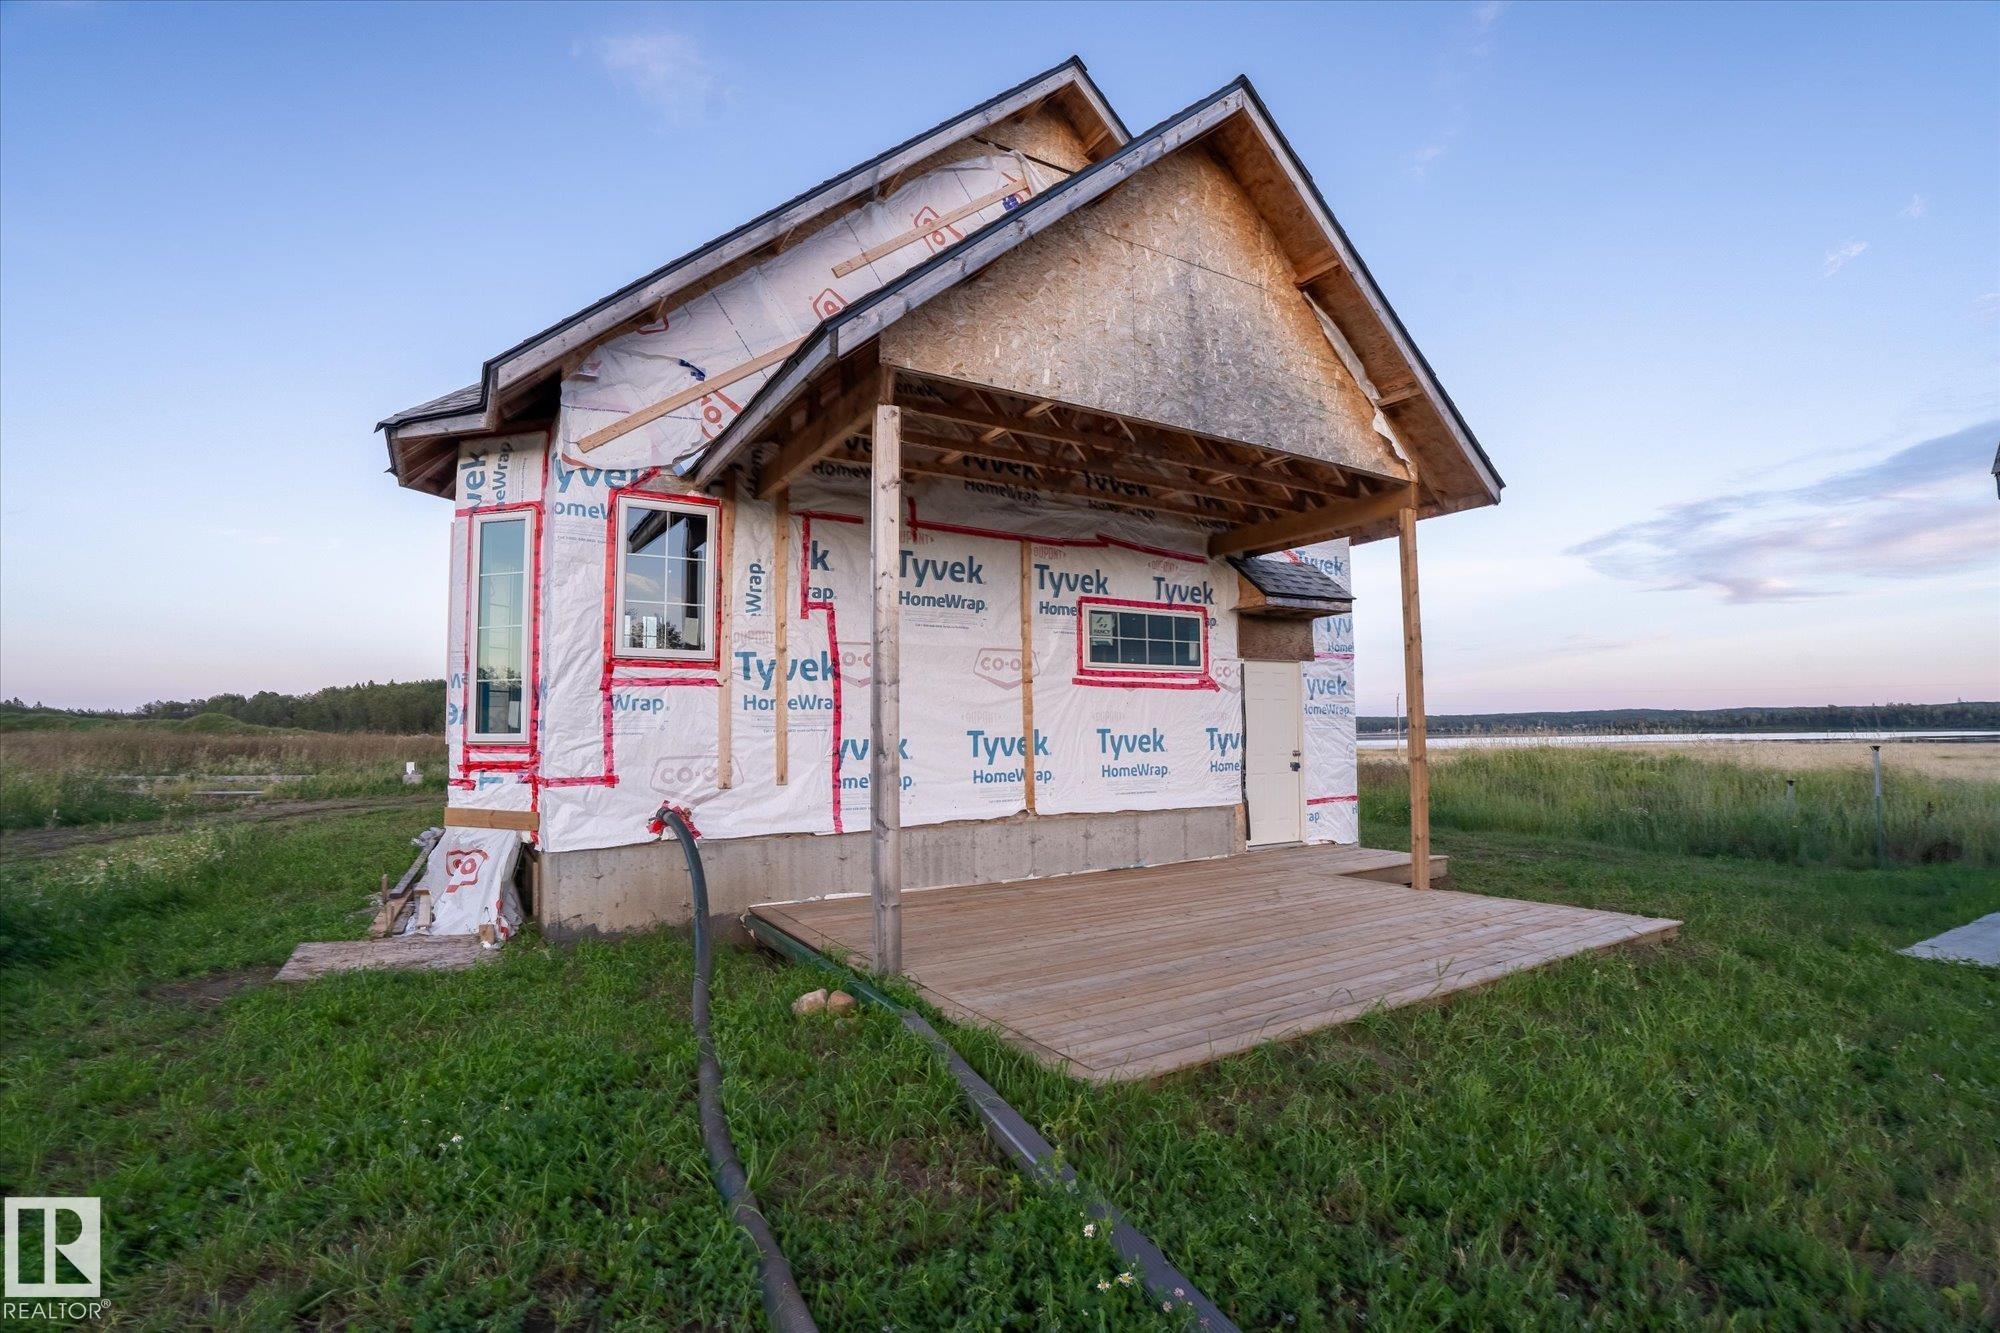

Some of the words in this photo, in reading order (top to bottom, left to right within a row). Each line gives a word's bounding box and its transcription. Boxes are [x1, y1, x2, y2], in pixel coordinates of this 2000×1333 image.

[899, 550, 983, 588] Tyvek
[1034, 563, 1109, 598] Tyvek
[745, 563, 766, 616] Wrap
[899, 590, 986, 614] HomeWrap
[1153, 576, 1215, 606] Tyvek
[1303, 673, 1347, 701] yvek
[1097, 727, 1165, 761] Tyvek
[1101, 762, 1168, 779] HomeWrap
[1210, 759, 1242, 773] Home
